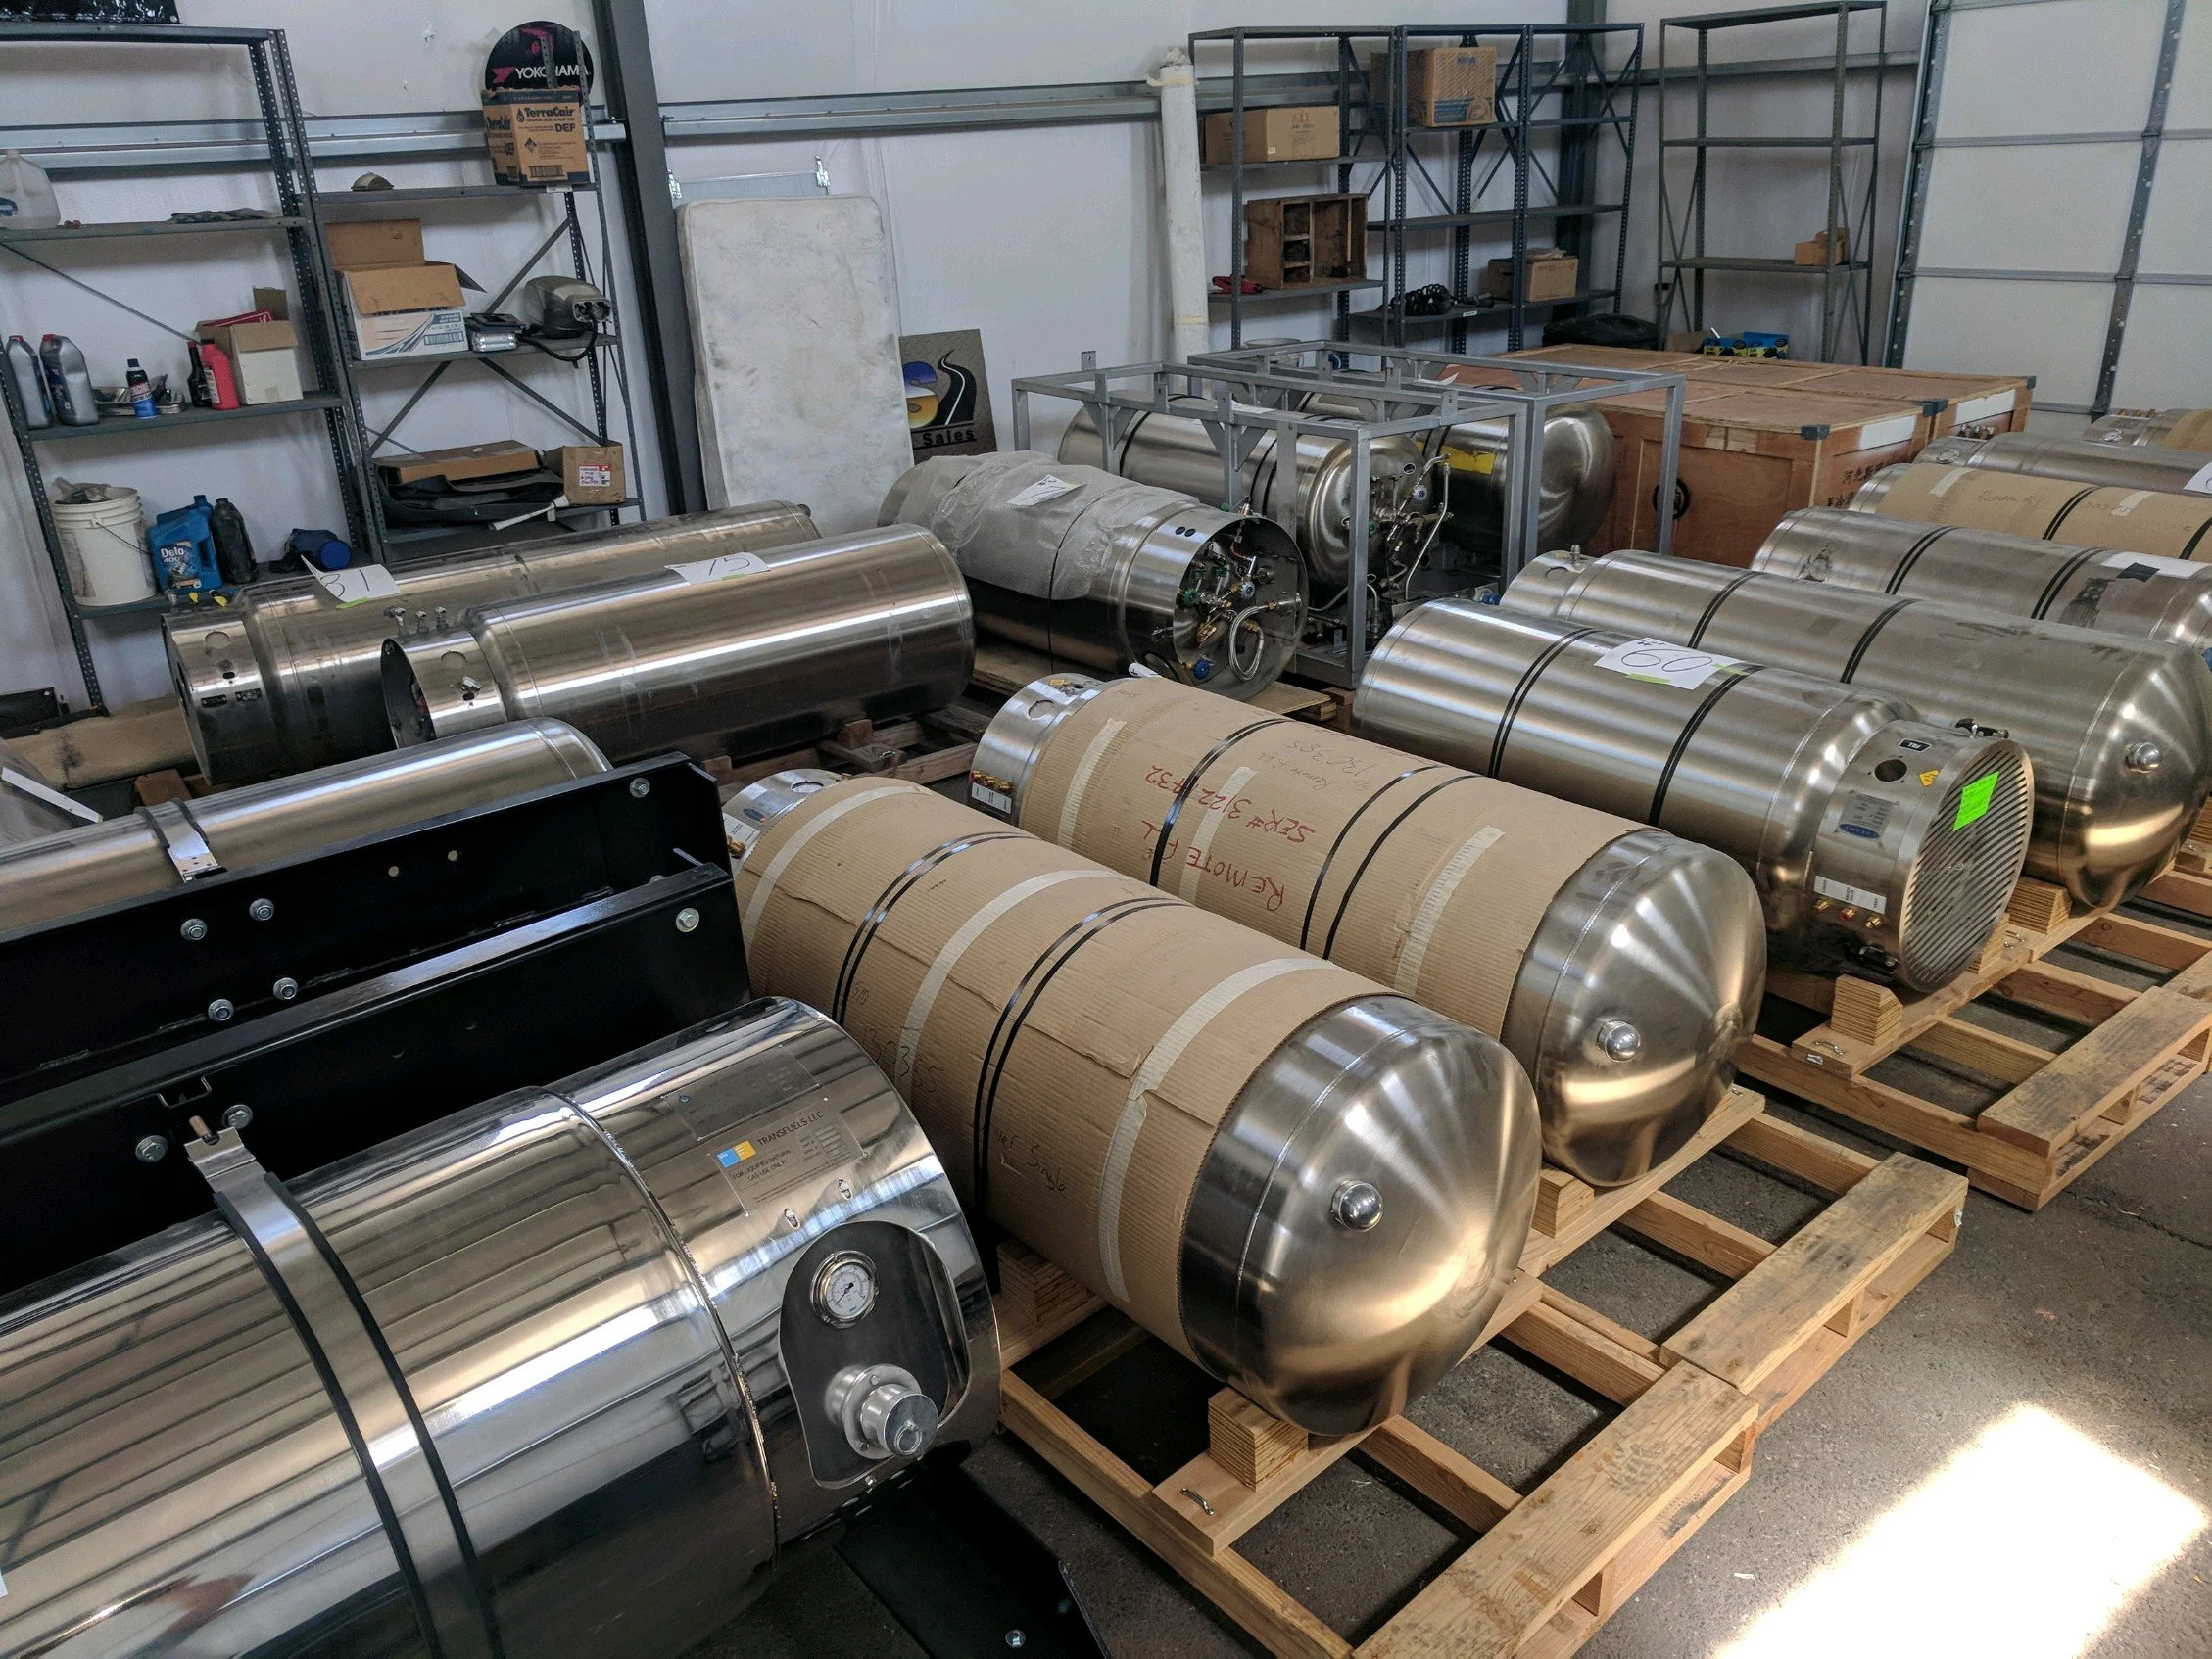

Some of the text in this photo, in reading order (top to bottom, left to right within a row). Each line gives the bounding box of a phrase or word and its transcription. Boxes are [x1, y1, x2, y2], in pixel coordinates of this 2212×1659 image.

[524, 106, 574, 118] TerraCair
[554, 122, 576, 133] DEF
[922, 429, 976, 447] Sales
[160, 546, 184, 558] Delo
[1620, 648, 1713, 673] 60
[1185, 845, 1285, 913] REMOTE
[756, 1111, 825, 1147] TRANSFUELS LLC
